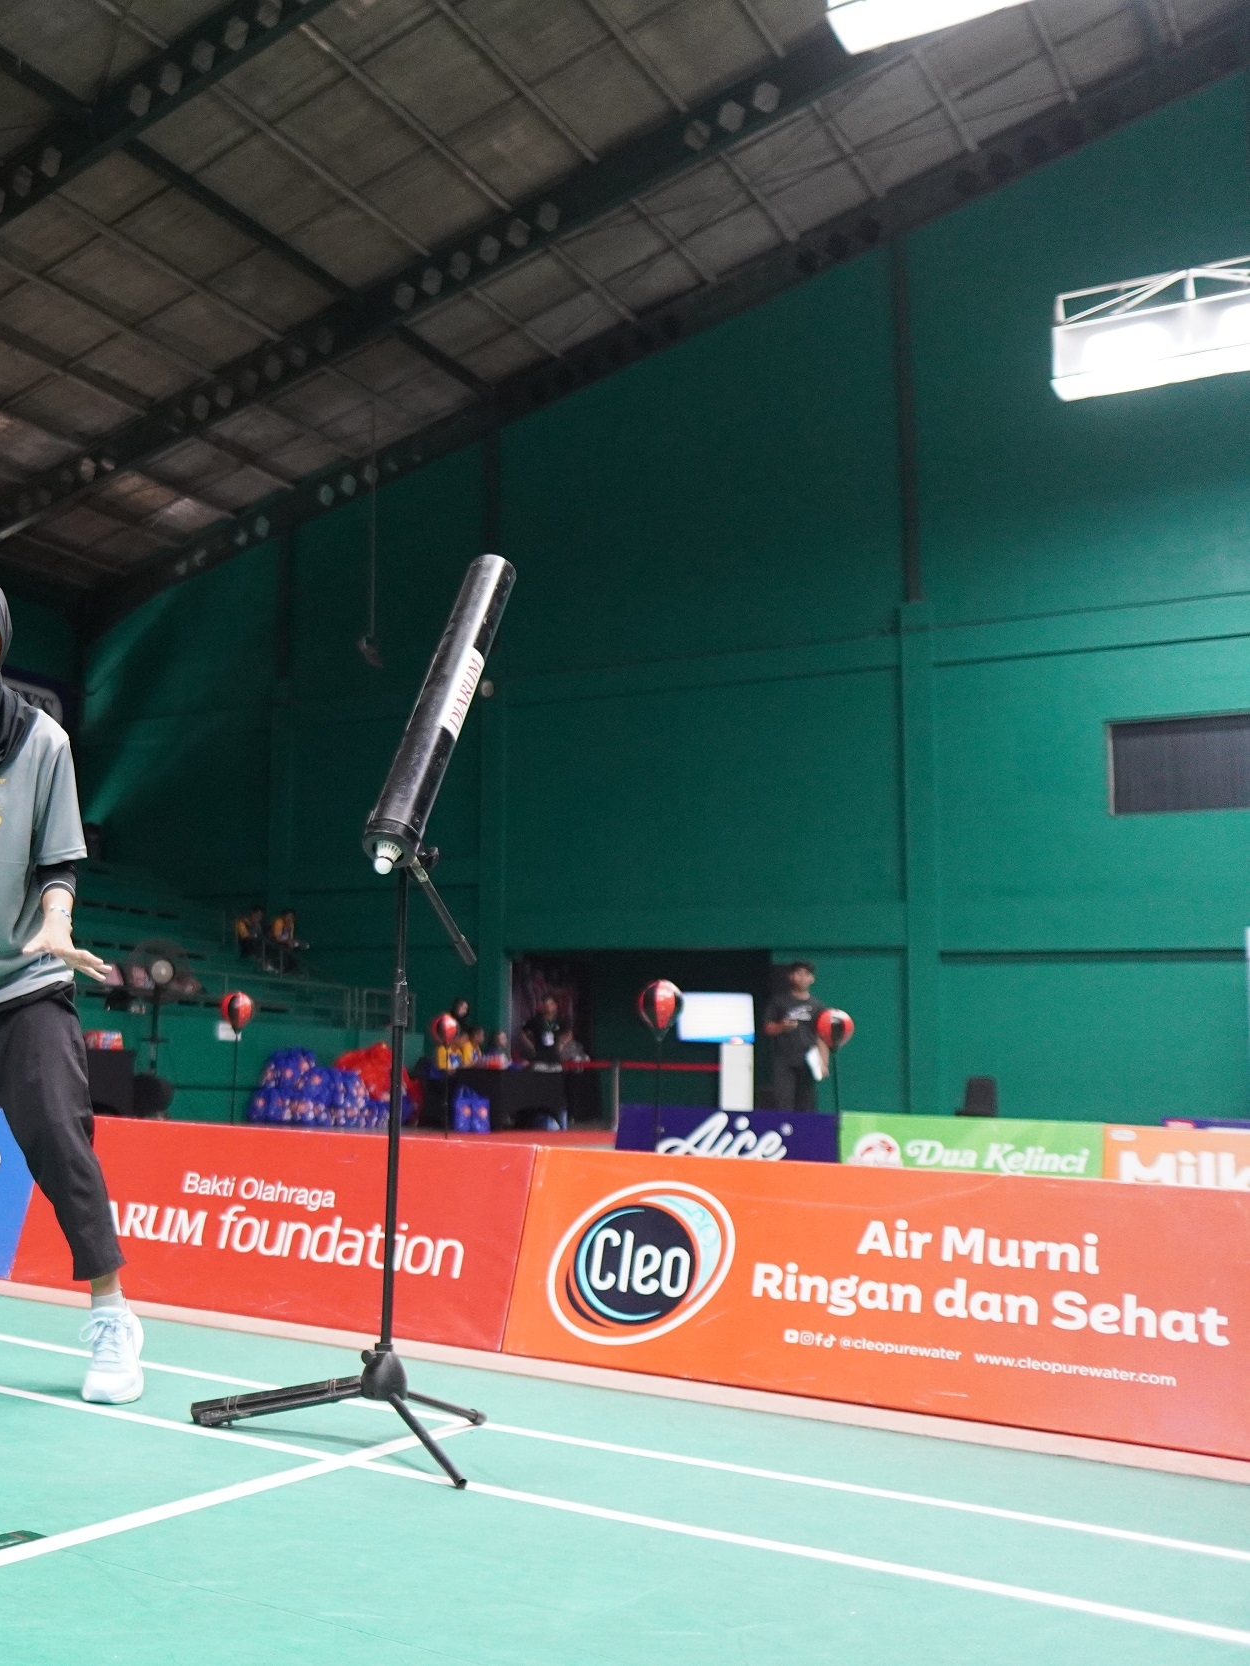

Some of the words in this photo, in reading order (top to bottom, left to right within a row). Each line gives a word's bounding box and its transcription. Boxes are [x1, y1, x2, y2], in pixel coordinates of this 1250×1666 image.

[655, 1111, 787, 1161] Aice
[906, 1139, 976, 1168] Dua
[982, 1143, 1090, 1176] Kelinci
[182, 1171, 235, 1198] Bakti
[239, 1177, 337, 1210] Olahraga
[218, 1204, 465, 1280] foundation
[590, 1227, 692, 1299] Cleo
[856, 1218, 932, 1260] Air
[941, 1225, 1100, 1275] Murni
[751, 1262, 922, 1318] Ringan
[933, 1277, 1039, 1326] dan
[1051, 1290, 1230, 1348] Sehat
[839, 1336, 962, 1361] @cleopurewater
[973, 1351, 1178, 1388] www.cleopurewater.com
